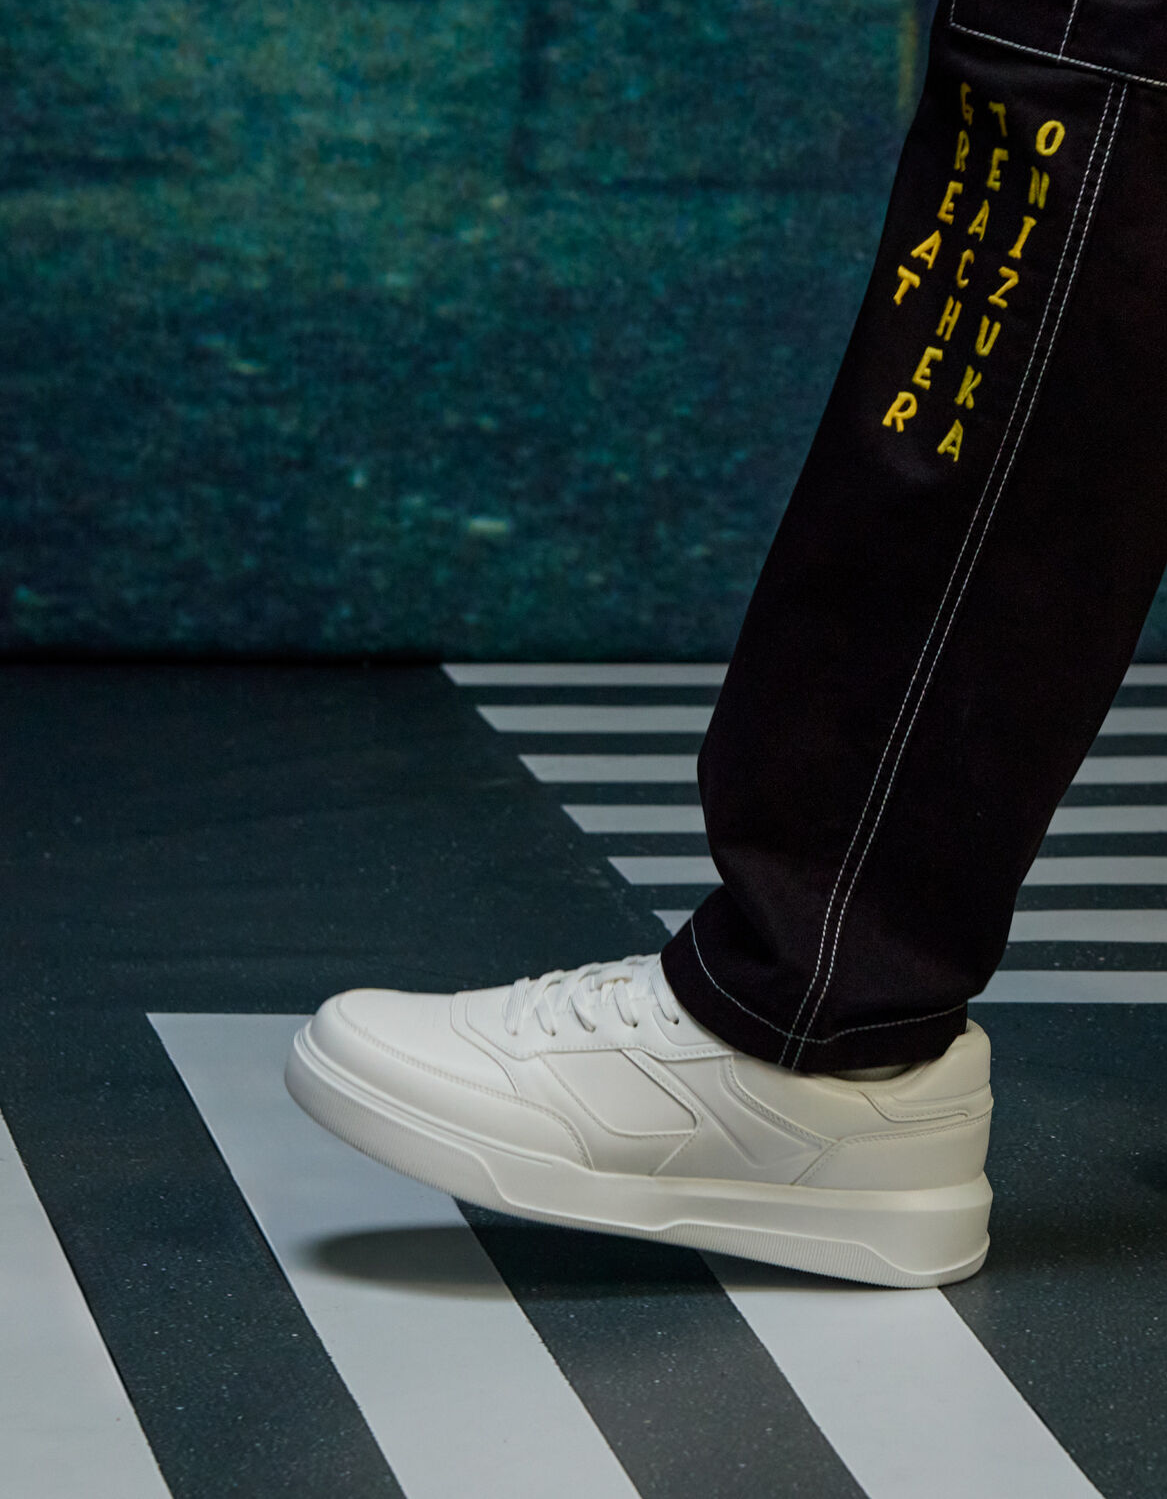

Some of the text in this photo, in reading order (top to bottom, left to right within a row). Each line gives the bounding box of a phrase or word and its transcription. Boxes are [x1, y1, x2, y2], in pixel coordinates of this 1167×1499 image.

[882, 101, 1009, 433] TEACHER
[892, 82, 975, 306] GREAT
[936, 120, 1066, 462] ONIZUKA
